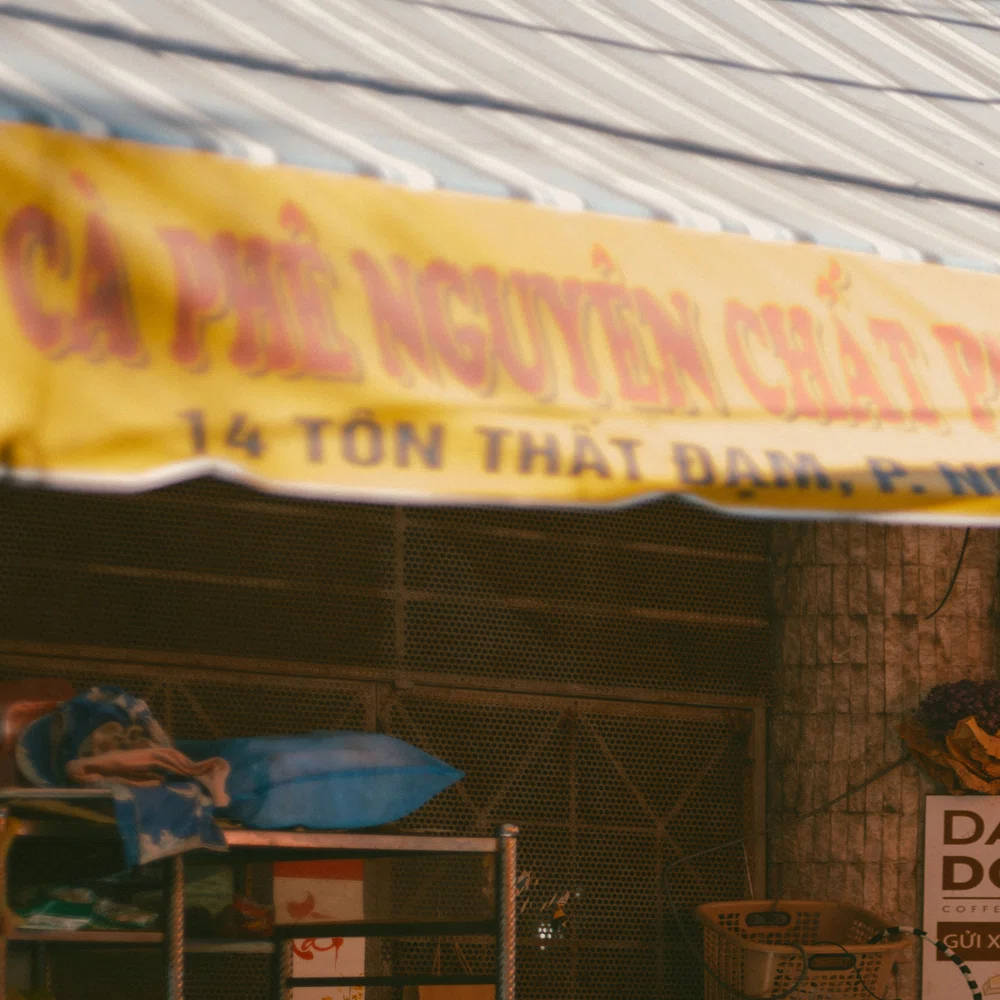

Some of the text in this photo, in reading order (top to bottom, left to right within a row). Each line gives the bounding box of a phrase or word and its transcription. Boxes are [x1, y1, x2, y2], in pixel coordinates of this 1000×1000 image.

[182, 410, 264, 458] 14
[297, 410, 443, 470] TÔN
[942, 930, 981, 950] GỬI
